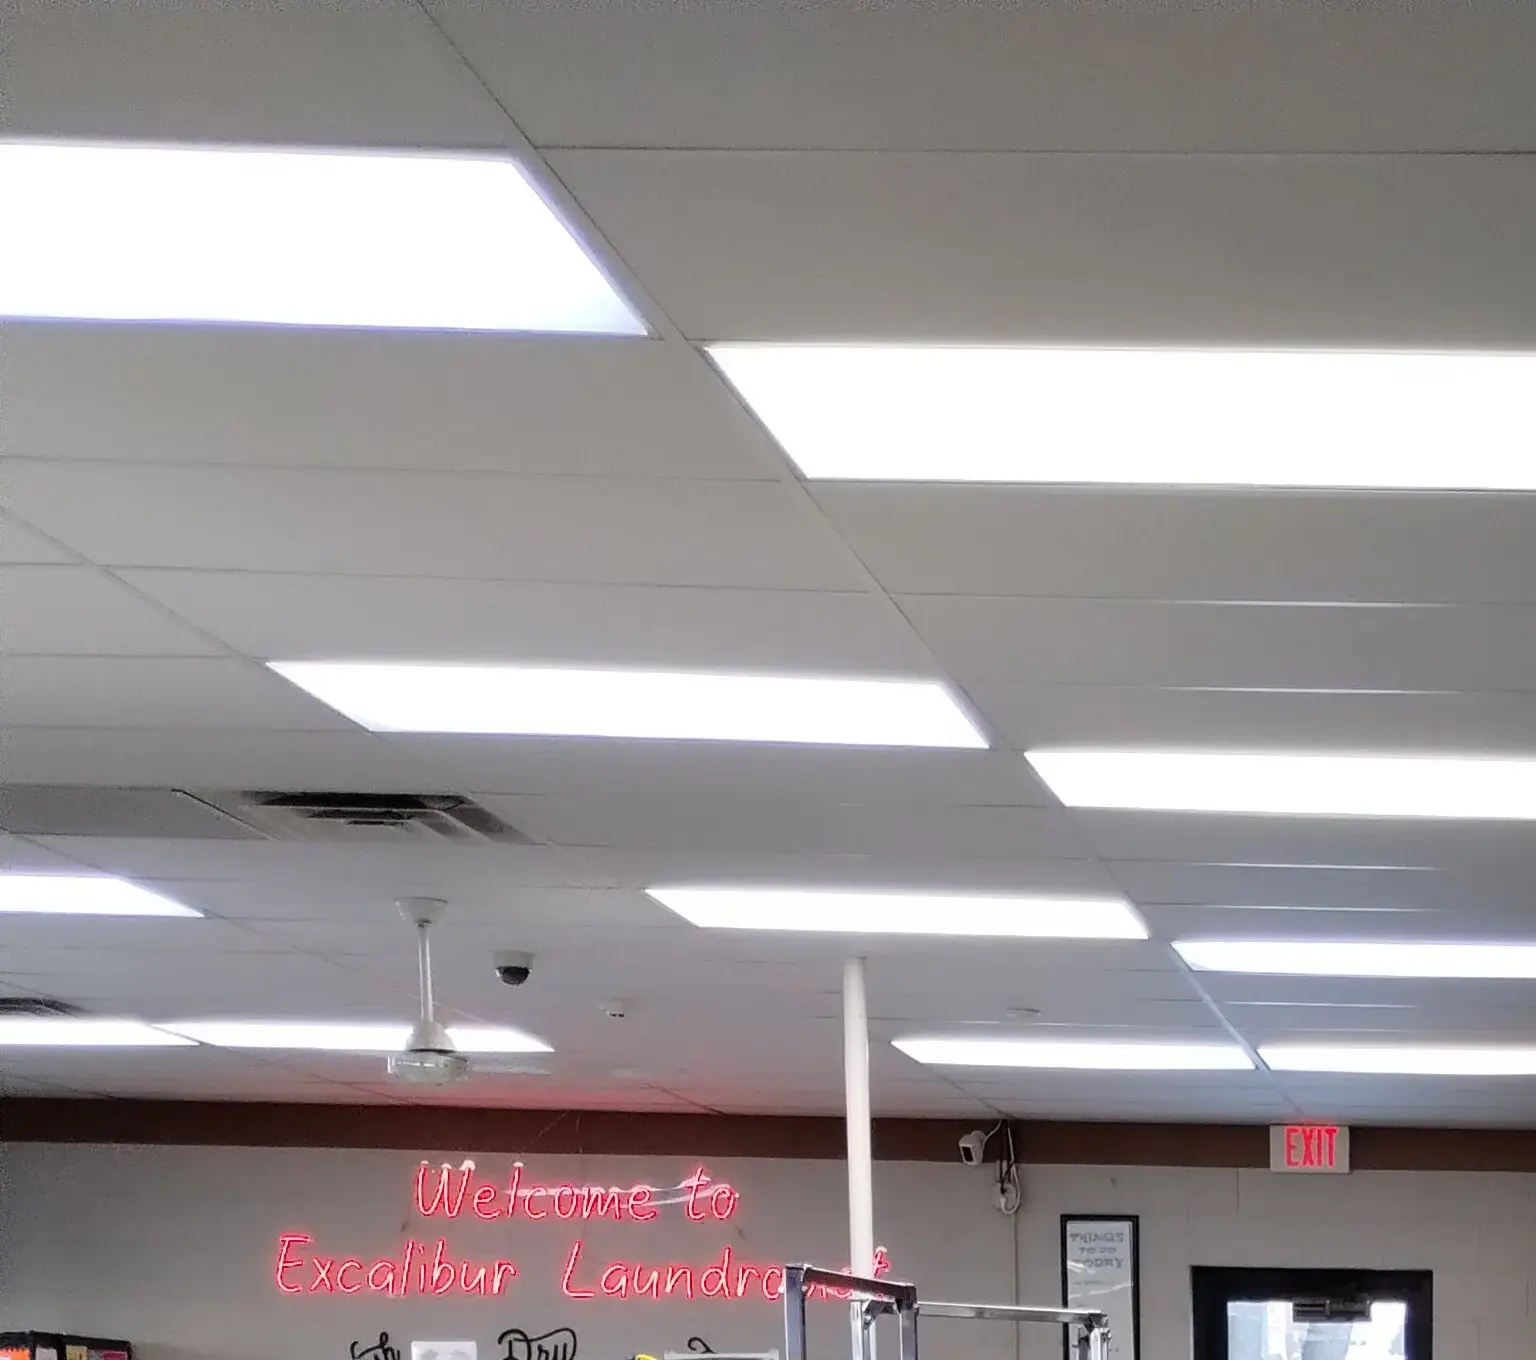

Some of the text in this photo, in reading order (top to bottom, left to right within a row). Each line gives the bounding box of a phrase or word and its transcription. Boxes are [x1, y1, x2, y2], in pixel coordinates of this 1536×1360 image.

[1285, 1126, 1338, 1167] EXIT
[415, 1163, 739, 1220] Welcome to
[276, 1235, 517, 1296] Excalibur
